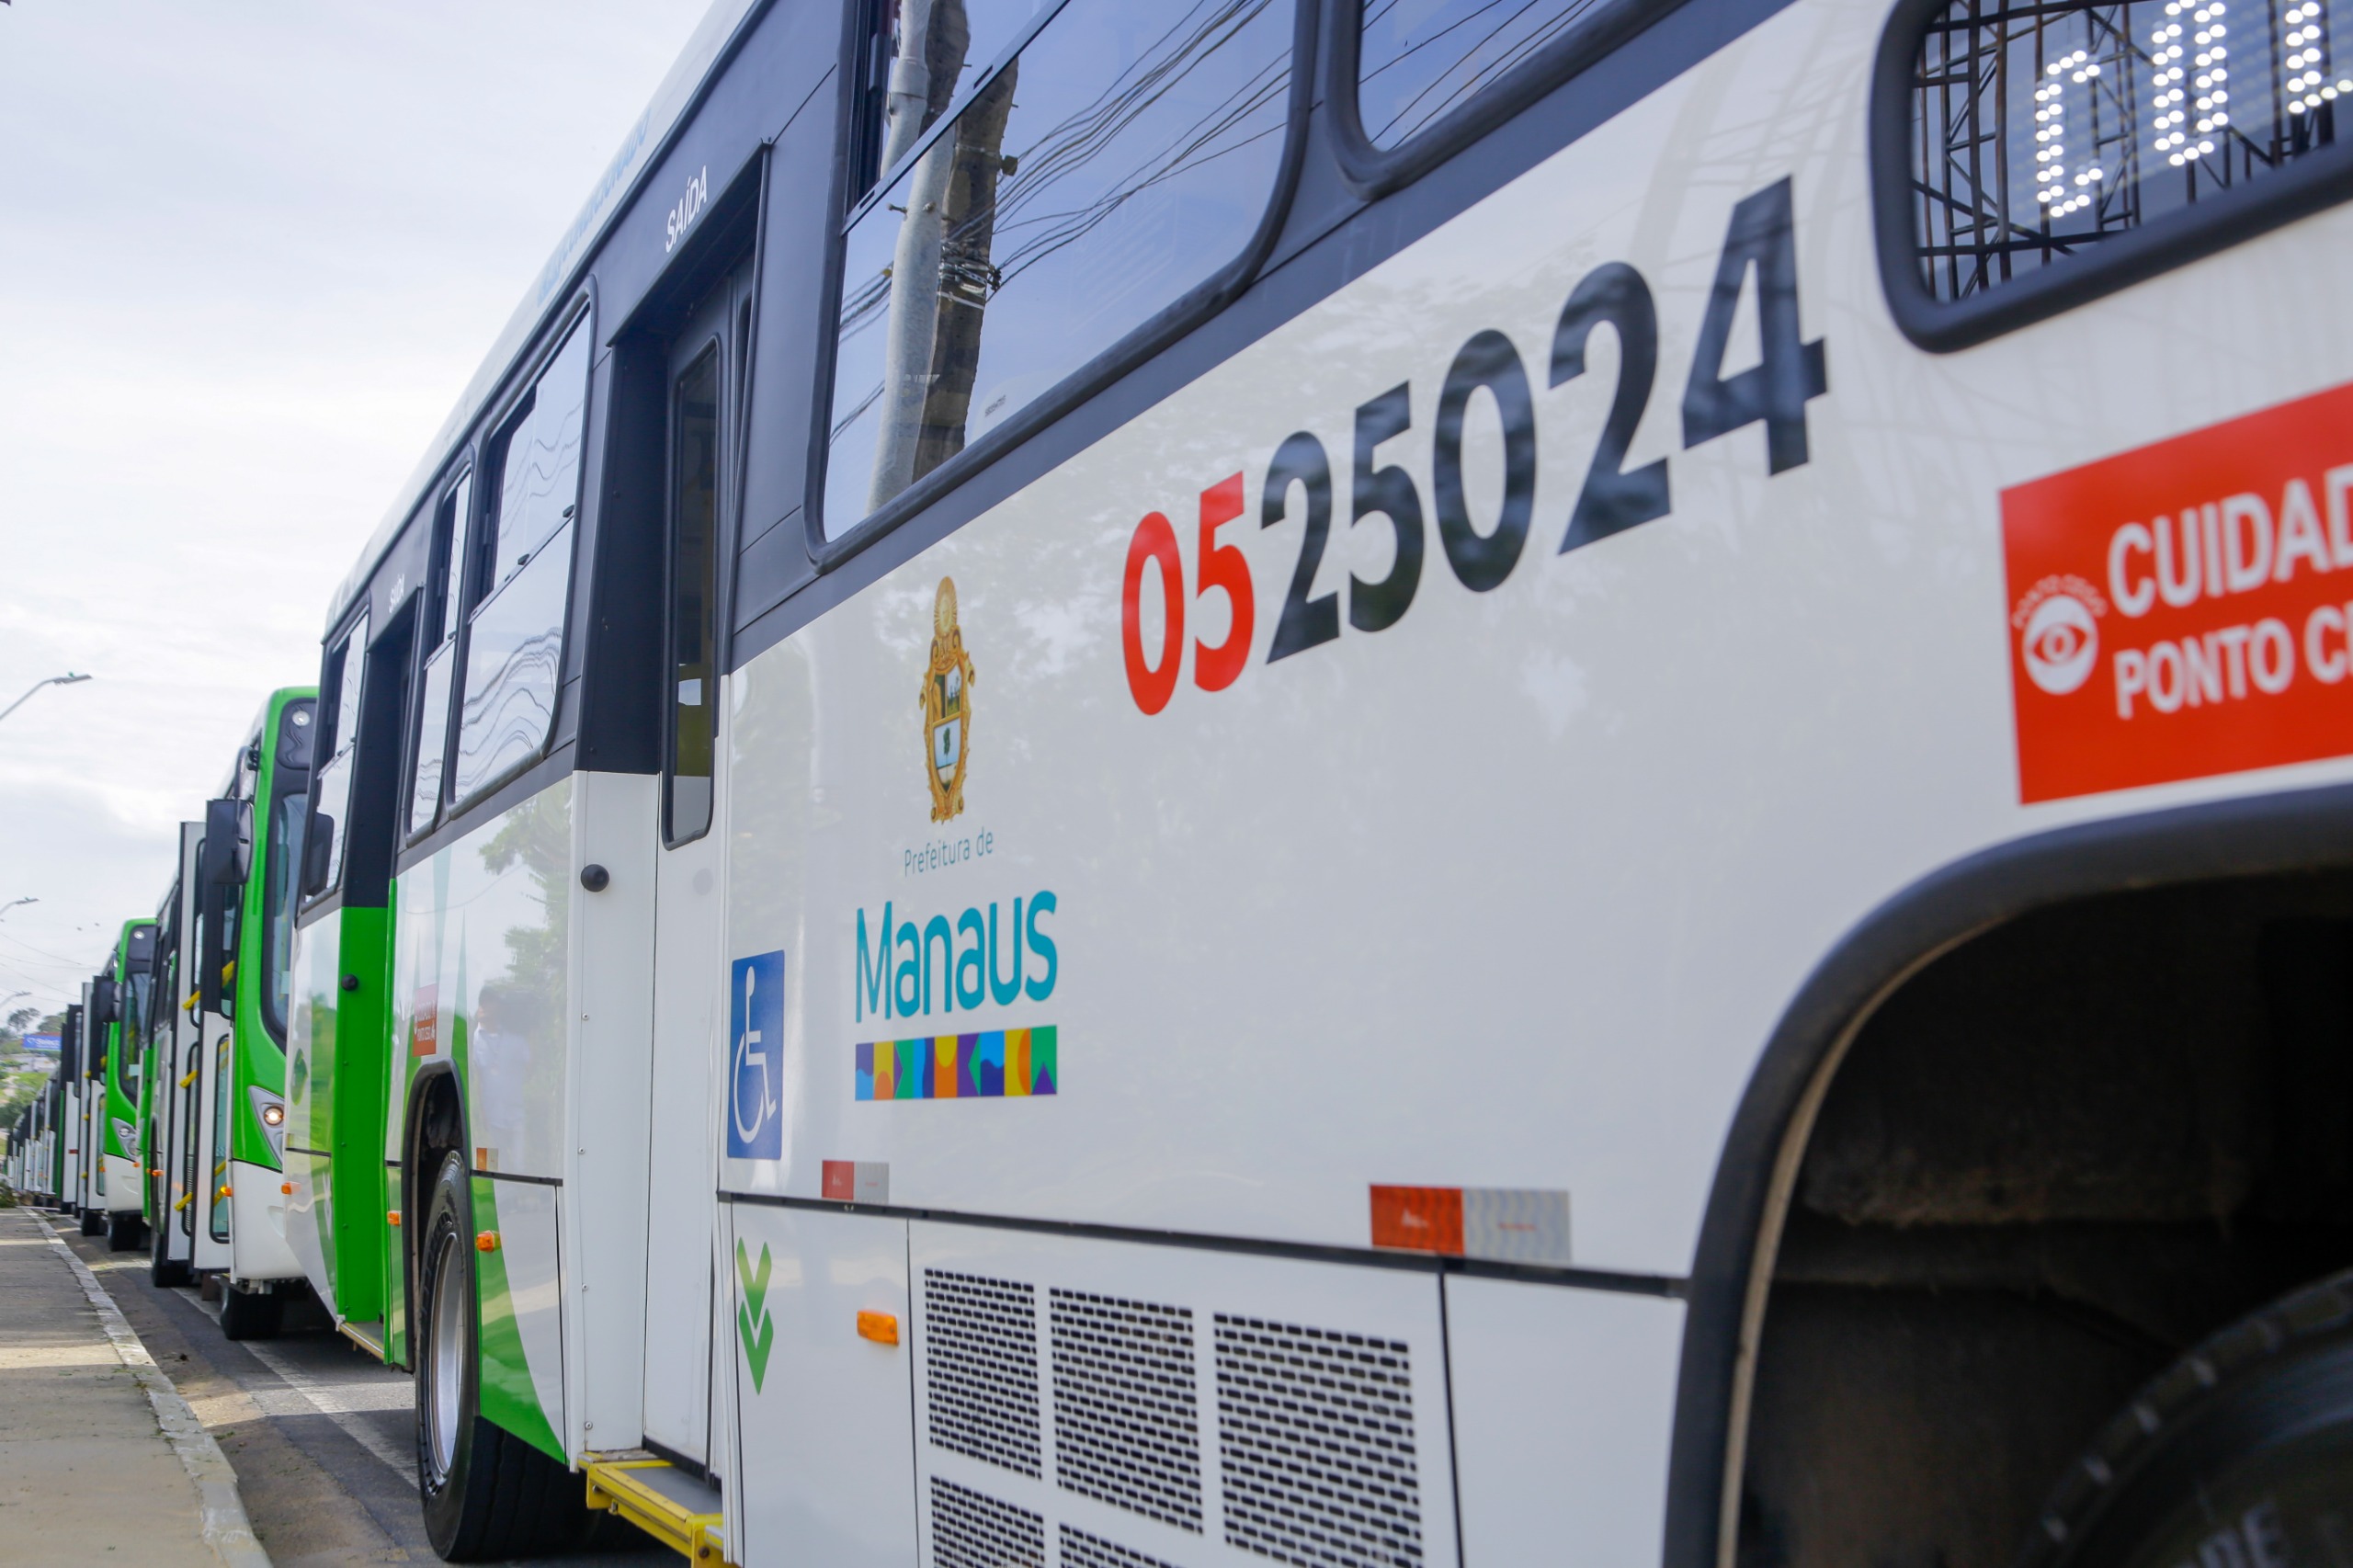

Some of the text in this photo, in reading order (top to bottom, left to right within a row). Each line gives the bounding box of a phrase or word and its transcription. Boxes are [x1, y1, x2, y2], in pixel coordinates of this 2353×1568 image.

[665, 165, 707, 253] SAÍDA
[2113, 599, 2353, 720] PONTO C
[904, 825, 994, 877] Prefeitura de
[855, 890, 1058, 1023] Manaus
